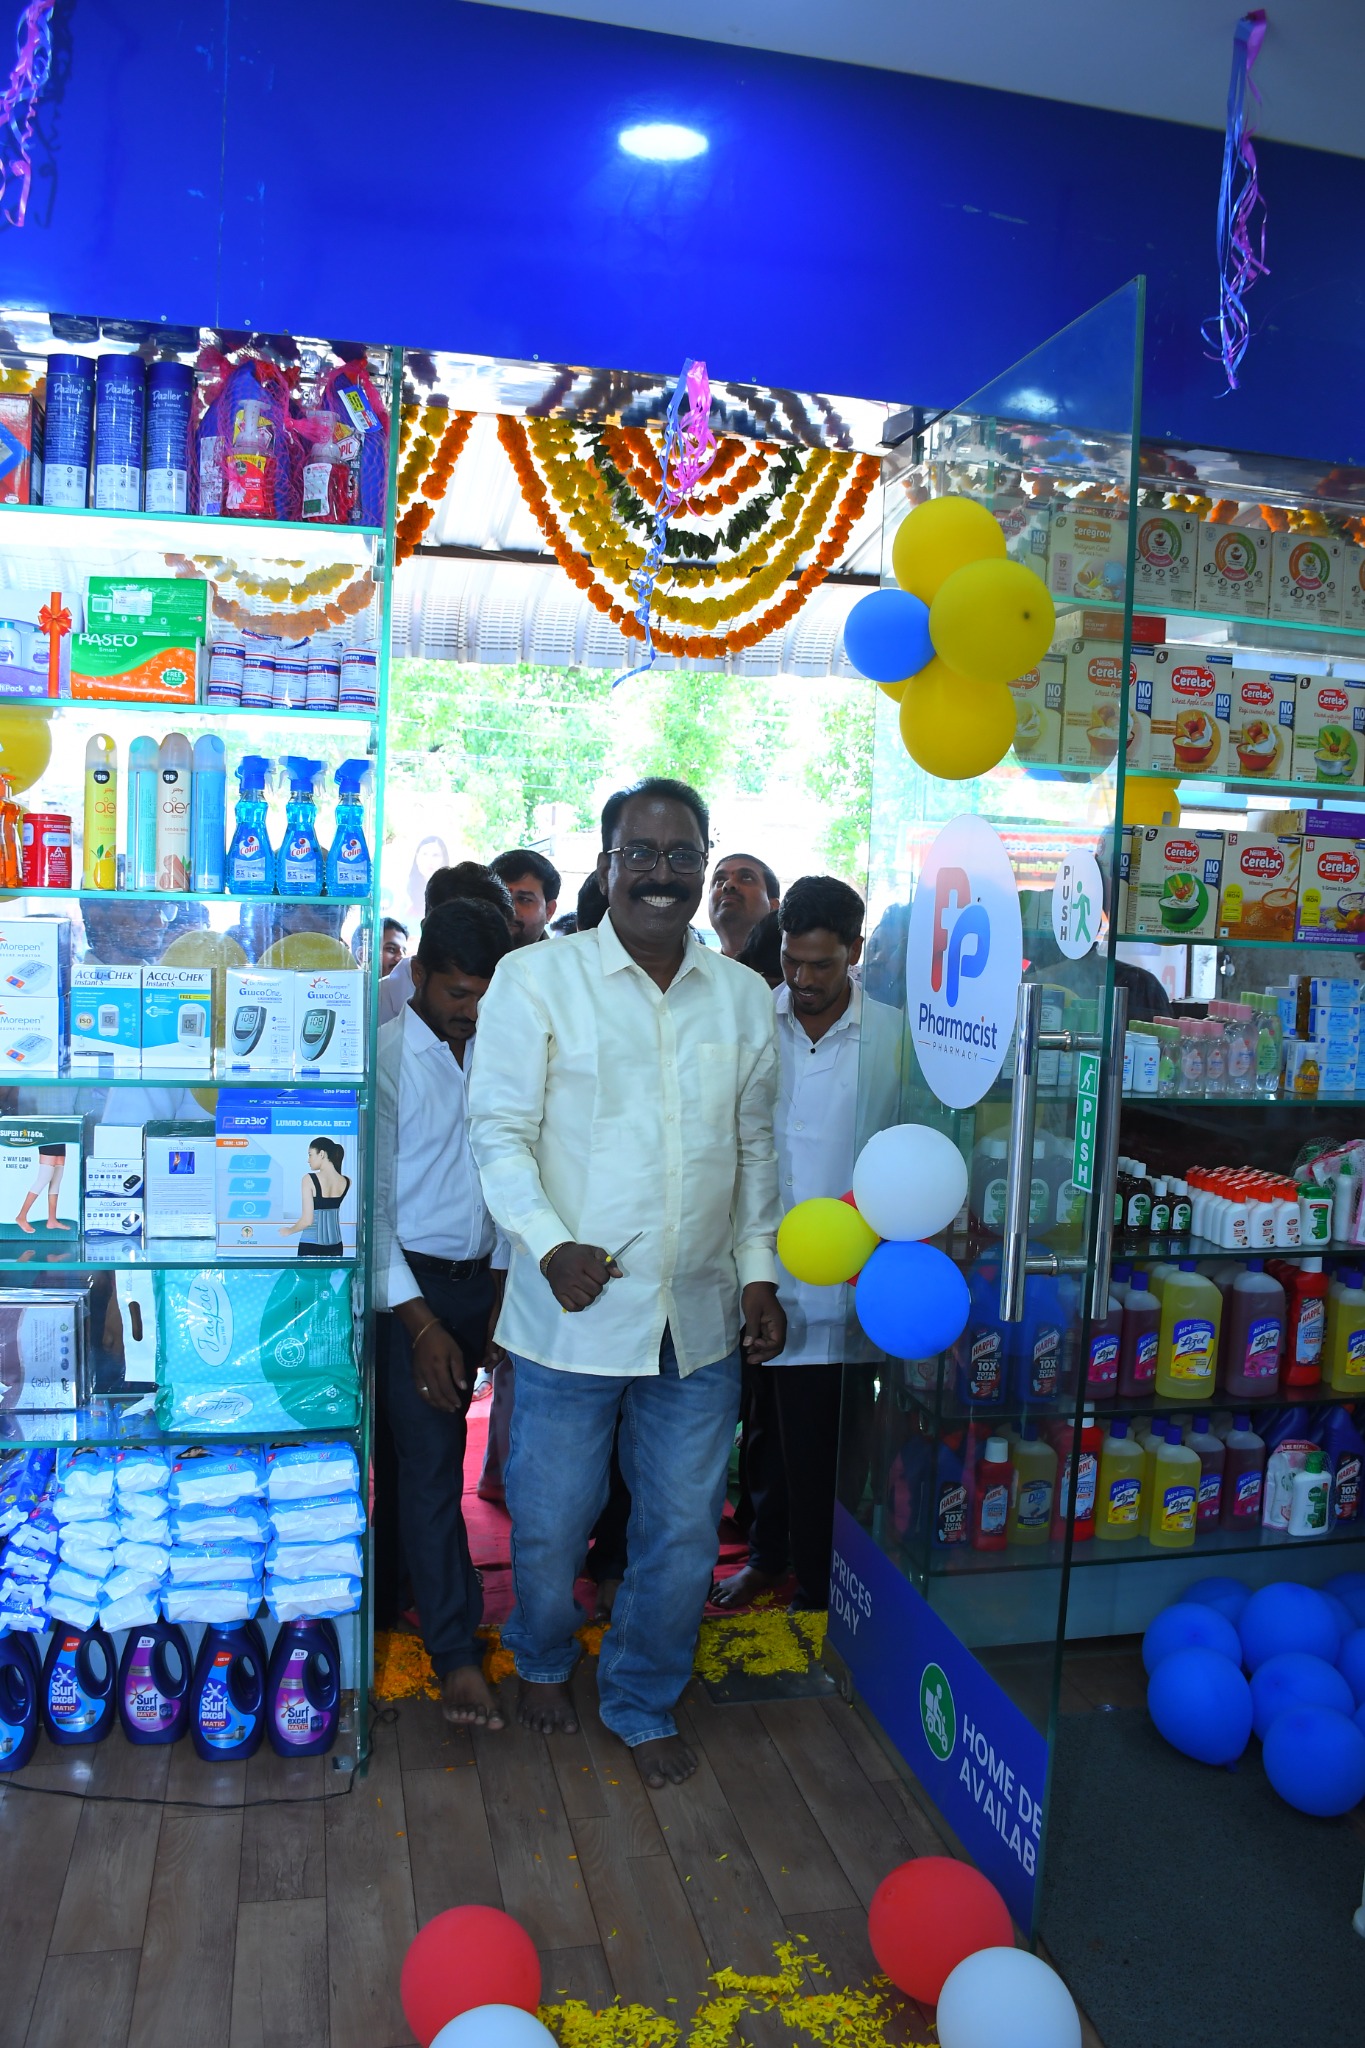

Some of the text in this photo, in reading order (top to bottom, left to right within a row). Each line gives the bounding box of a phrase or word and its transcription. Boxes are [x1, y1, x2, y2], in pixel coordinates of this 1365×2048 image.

[78, 634, 138, 648] PASEO
[1172, 674, 1212, 688] Cerelac
[1047, 684, 1061, 697] NO
[1138, 682, 1152, 698] NO
[1242, 688, 1272, 700] Cerelac
[1217, 696, 1230, 708] NO
[1319, 695, 1346, 706] Cerelac
[1280, 702, 1293, 714] NO
[1354, 708, 1365, 720] NO
[1148, 830, 1155, 838] 12
[1229, 835, 1237, 843] 12
[240, 844, 259, 855] Colin
[1306, 841, 1314, 849] 18
[290, 846, 311, 858] Colin
[342, 848, 362, 859] Colin
[1165, 847, 1196, 858] Cerelac
[1206, 860, 1219, 873] NO
[1242, 856, 1281, 869] Cerelac
[1318, 860, 1357, 874] Cerelac
[1059, 864, 1071, 942] PUSH
[0, 943, 41, 952] Morepen
[75, 970, 134, 980] ACCU-CHEK
[146, 971, 204, 982] ACCU-CHEK
[0, 1016, 41, 1026] Morepen
[241, 1013, 255, 1023] 108
[309, 1016, 323, 1026] 108
[918, 1002, 998, 1050] Pharmacist
[932, 1041, 978, 1062] PHARMACY
[333, 1120, 352, 1128] BELT
[1076, 1098, 1093, 1185] PUSH
[973, 1336, 996, 1356] HARPIC
[1035, 1334, 1056, 1355] HARPIC
[1180, 1335, 1207, 1350] Lizol
[977, 1362, 997, 1372] 10X
[1040, 1359, 1057, 1369] 10X
[1341, 1486, 1357, 1495] 10X
[941, 1494, 962, 1509] HARPIC
[944, 1514, 962, 1523] 10X
[832, 1549, 872, 1618] PRICES
[52, 1682, 78, 1696] Surf
[51, 1694, 76, 1704] excel
[137, 1694, 158, 1705] Surf
[202, 1698, 228, 1711] Surf
[136, 1703, 157, 1711] excel
[288, 1705, 310, 1718] Surf
[201, 1710, 226, 1720] excel
[287, 1715, 308, 1724] excel
[962, 1713, 1043, 1841] HOME DE
[959, 1756, 1036, 1877] AVAILAB
